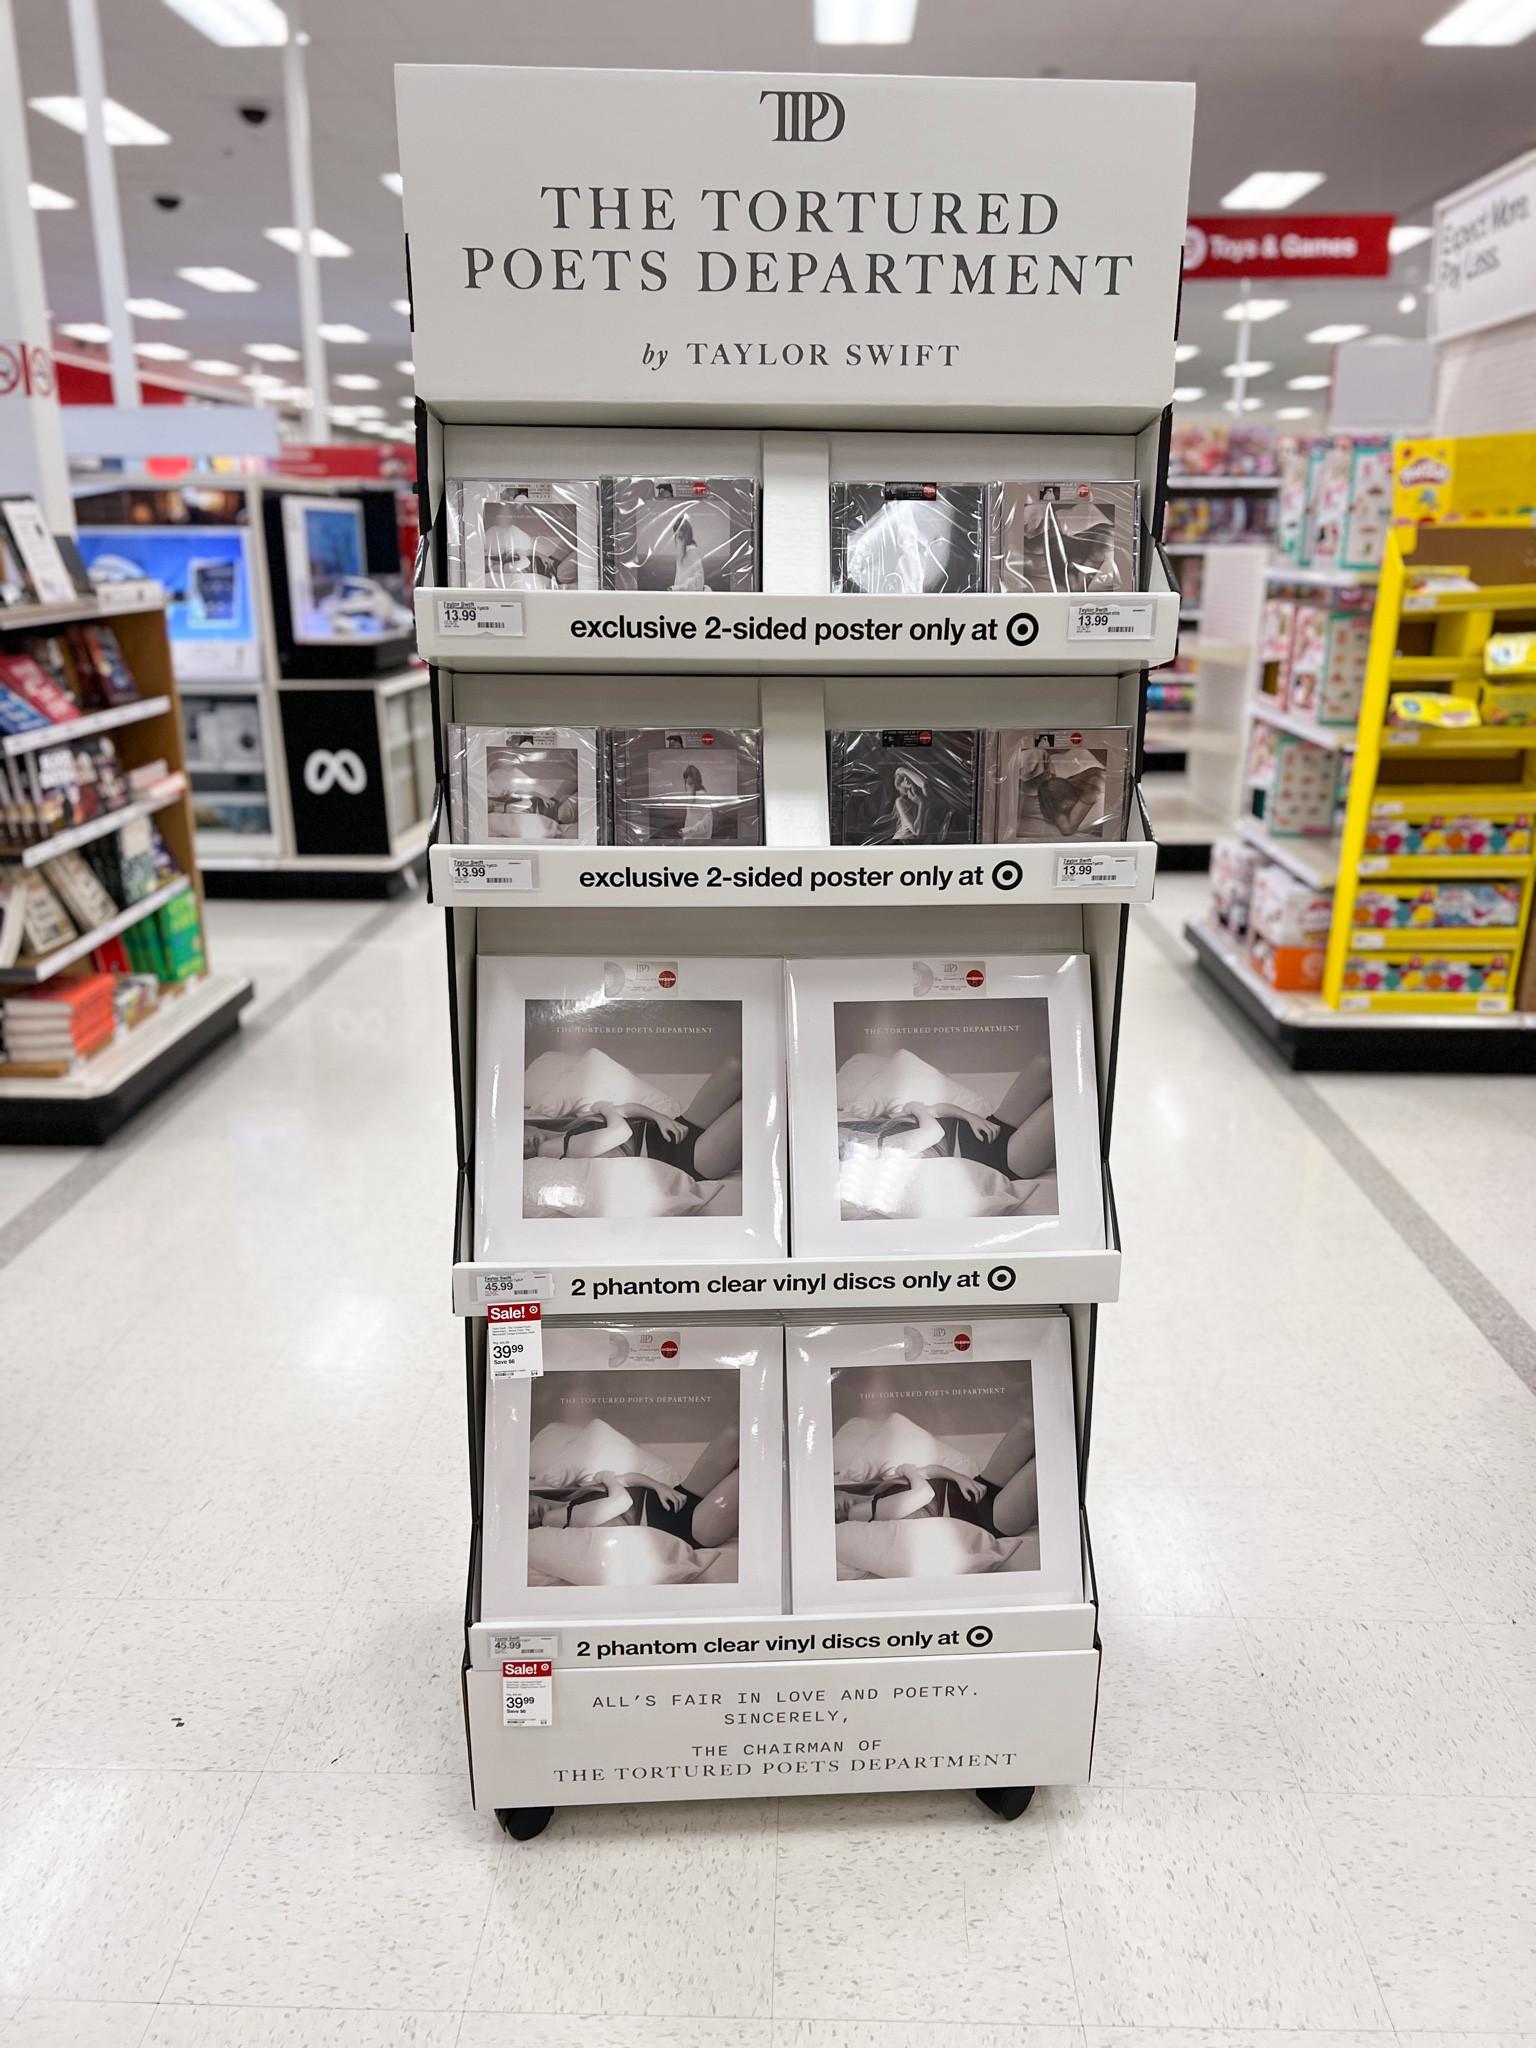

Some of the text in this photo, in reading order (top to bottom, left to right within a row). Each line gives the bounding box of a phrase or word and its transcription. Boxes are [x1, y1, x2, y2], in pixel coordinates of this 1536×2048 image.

[541, 186, 1058, 235] THE TORTURED
[1209, 232, 1359, 264] Toys & Games
[462, 247, 1133, 296] POETS DEPARTMENT
[642, 343, 960, 371] by TAYLOR SWIFT
[444, 610, 476, 621] 13.99
[1078, 615, 1108, 627] 13.99
[571, 615, 998, 646] exclusive 2-sided poster only at
[455, 867, 485, 877] 13.99
[1063, 865, 1092, 875] 13.99
[580, 865, 985, 892] exclusive 2-sided poster only at
[626, 1026, 653, 1034] POETS
[656, 1026, 713, 1034] DEPARTMENT
[885, 1027, 931, 1035] TORTURED
[933, 1026, 961, 1034] POETS
[963, 1025, 1021, 1033] DEPARTMENT
[485, 1282, 514, 1291] 45.99
[572, 1270, 981, 1300] 2 phantom clear vinyl discs only at
[490, 1306, 525, 1320] Sale!
[878, 1390, 922, 1399] TORTURED
[952, 1387, 1005, 1396] DEPARTMENT
[560, 1397, 578, 1405] THE
[628, 1396, 654, 1404] POETS
[494, 1642, 521, 1650] 45.99
[576, 1631, 960, 1660] 2 phantom clear vinyl discs only at
[505, 1664, 537, 1675] Sale!
[592, 1685, 978, 1708] ALL'S FAIR IN LOVE AND POETRY.
[724, 1710, 848, 1725] SINCERELY,
[692, 1739, 882, 1757] THE CHAIRMAN OF
[554, 1753, 1017, 1782] THE TORTURED POETS DEPARTMENT
